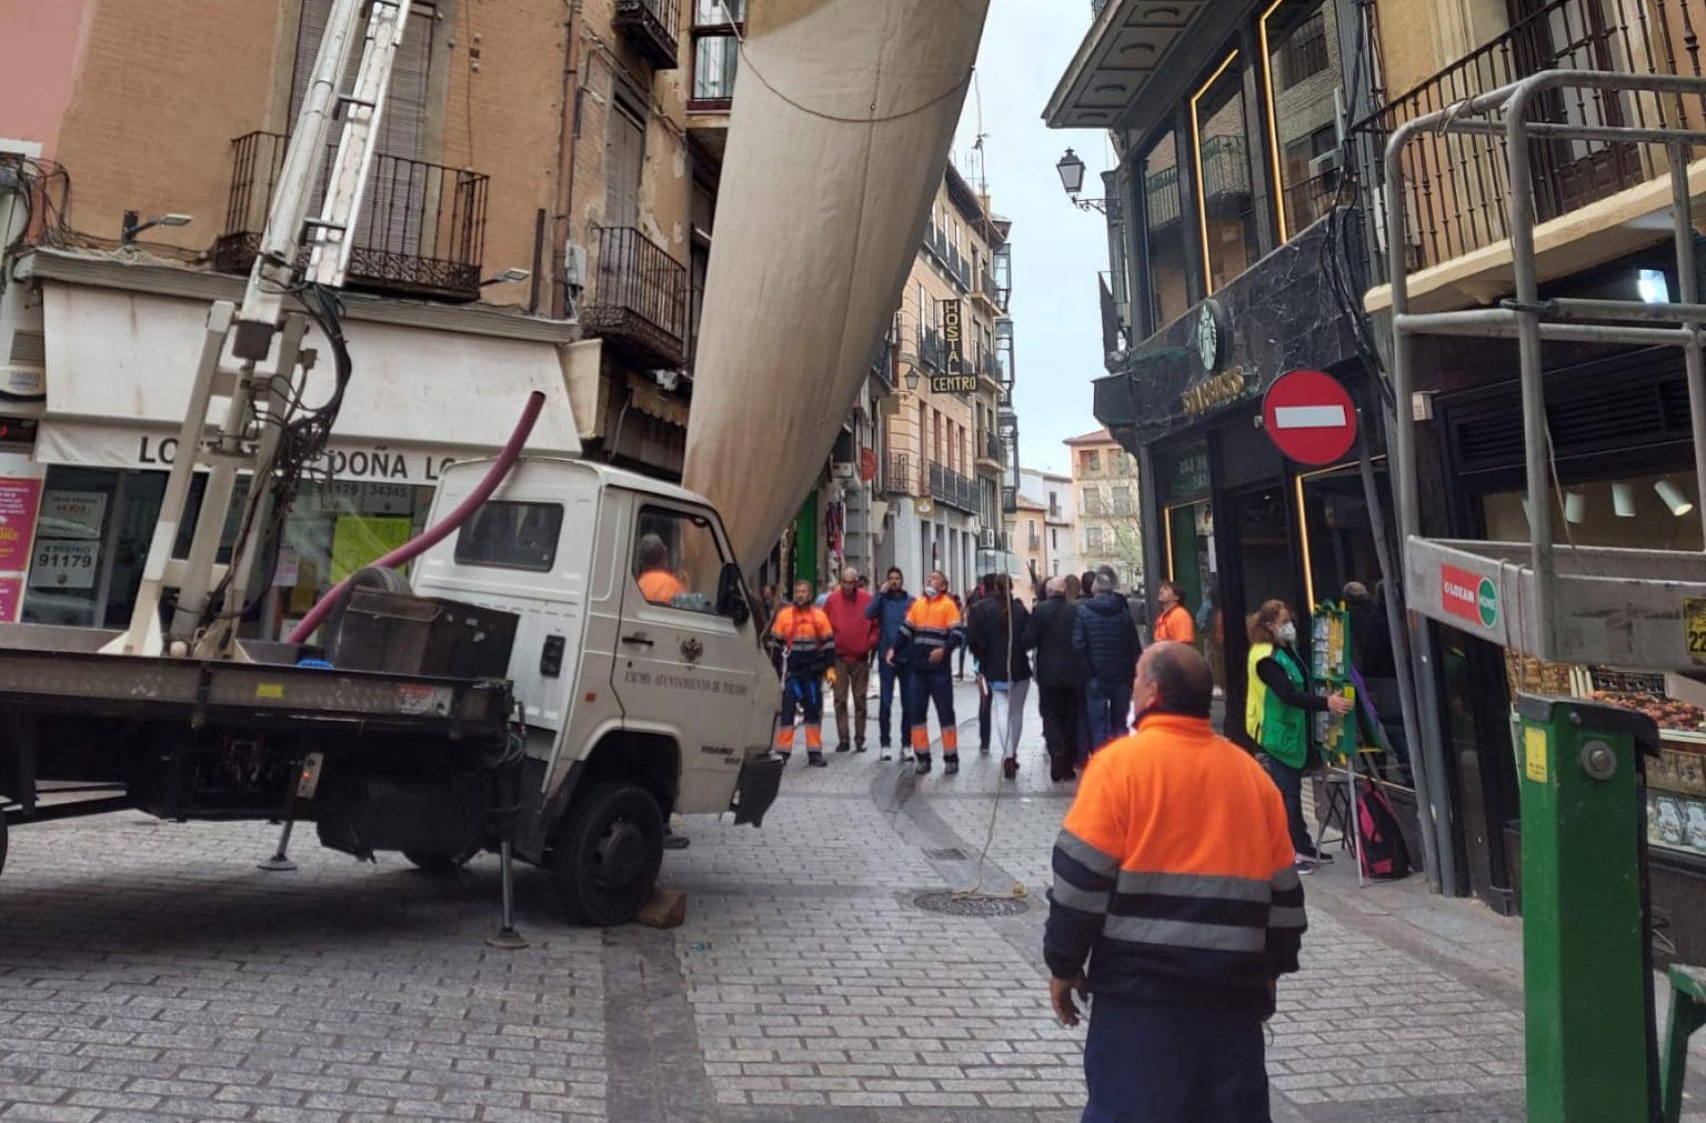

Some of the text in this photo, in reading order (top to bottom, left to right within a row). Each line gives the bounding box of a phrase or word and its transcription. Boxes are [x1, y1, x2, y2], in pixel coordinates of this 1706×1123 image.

[945, 301, 960, 375] HOSTAL
[933, 377, 976, 391] CENTRO
[329, 444, 407, 479] DOÑA
[39, 555, 92, 568] 91179
